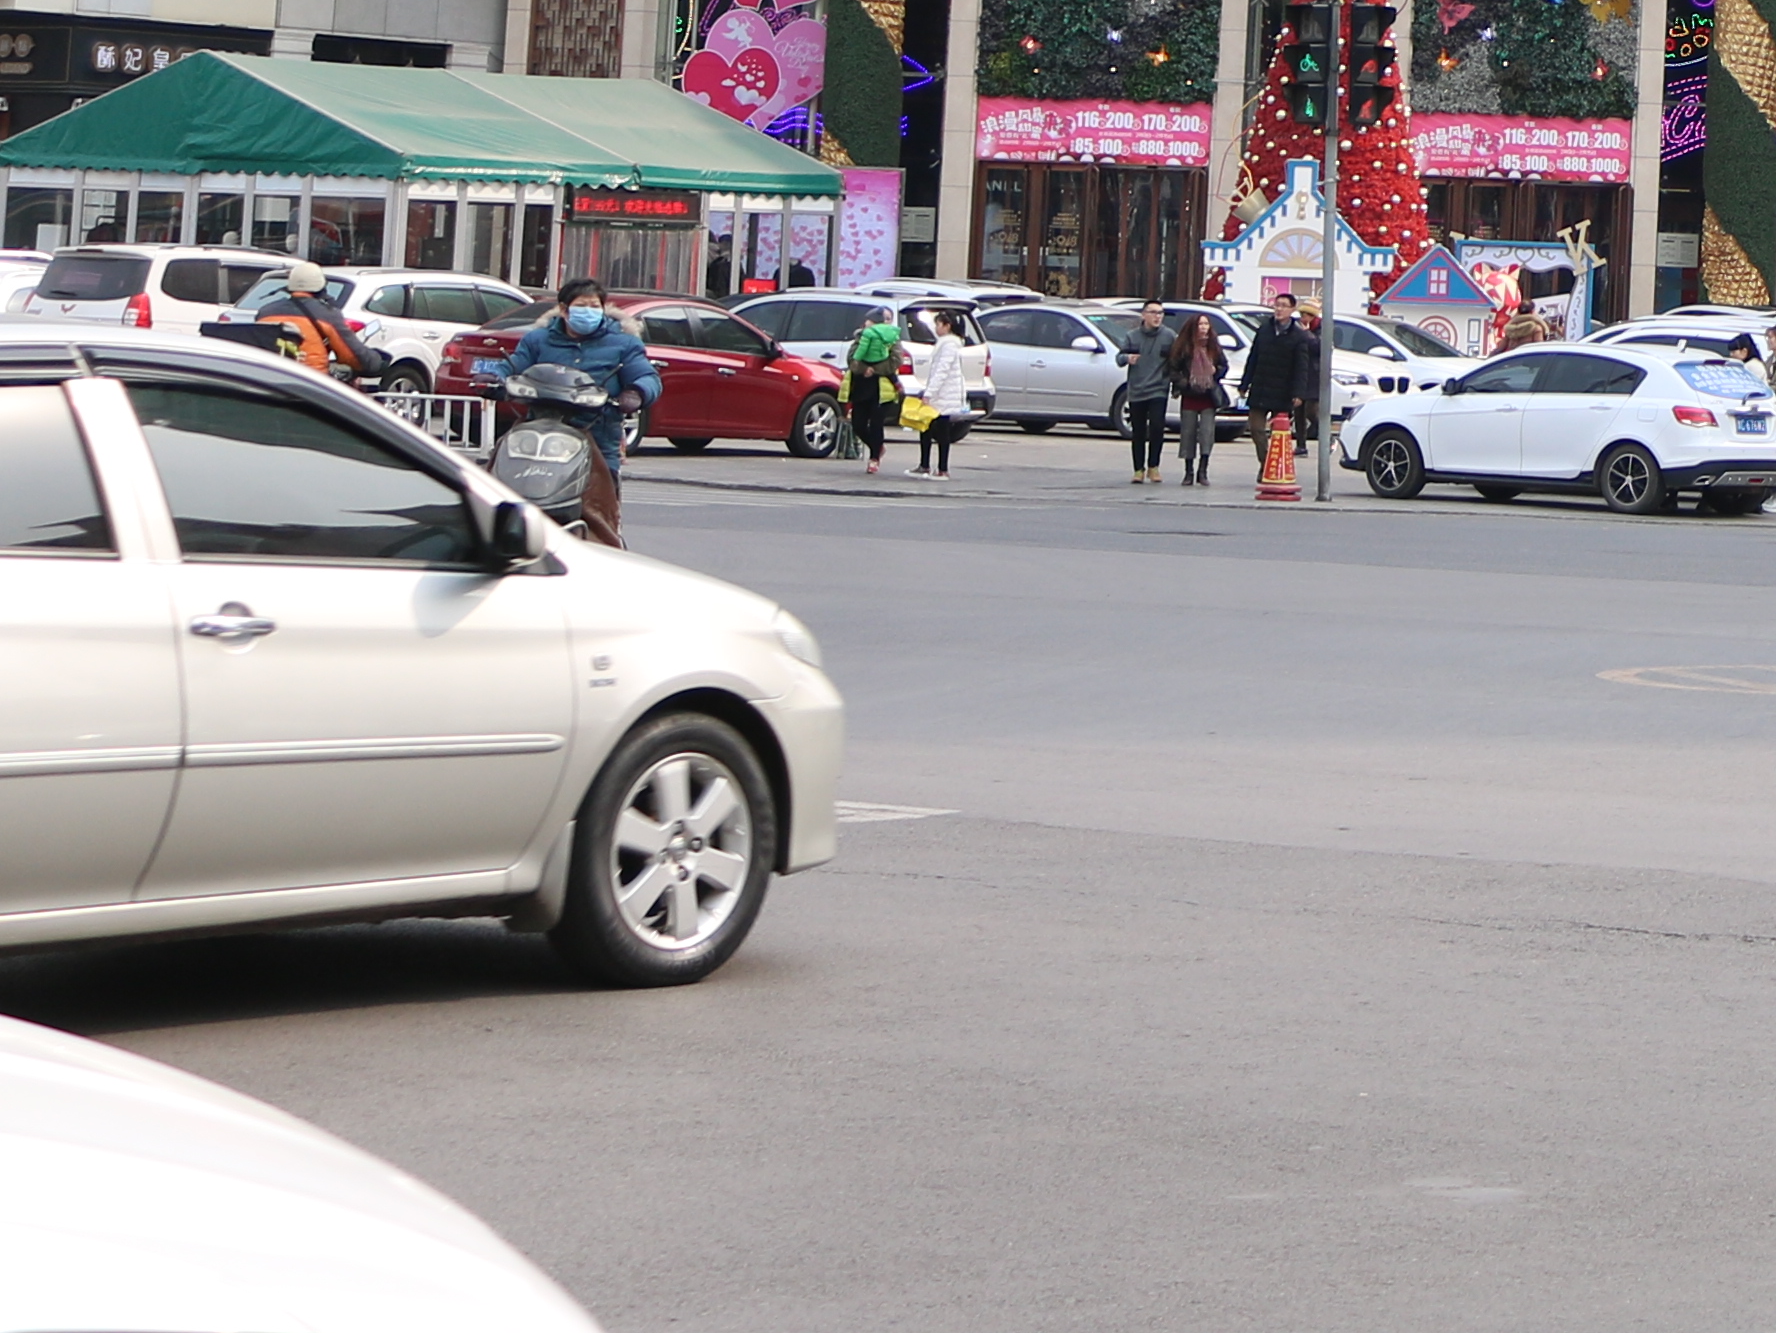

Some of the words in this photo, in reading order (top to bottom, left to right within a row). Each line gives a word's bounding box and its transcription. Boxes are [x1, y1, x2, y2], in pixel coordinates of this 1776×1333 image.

[97, 45, 194, 74] 酥妃皇
[1106, 113, 1134, 131] 200
[1173, 115, 1199, 132] 200
[1532, 129, 1558, 146] 200
[1595, 132, 1620, 149] 200
